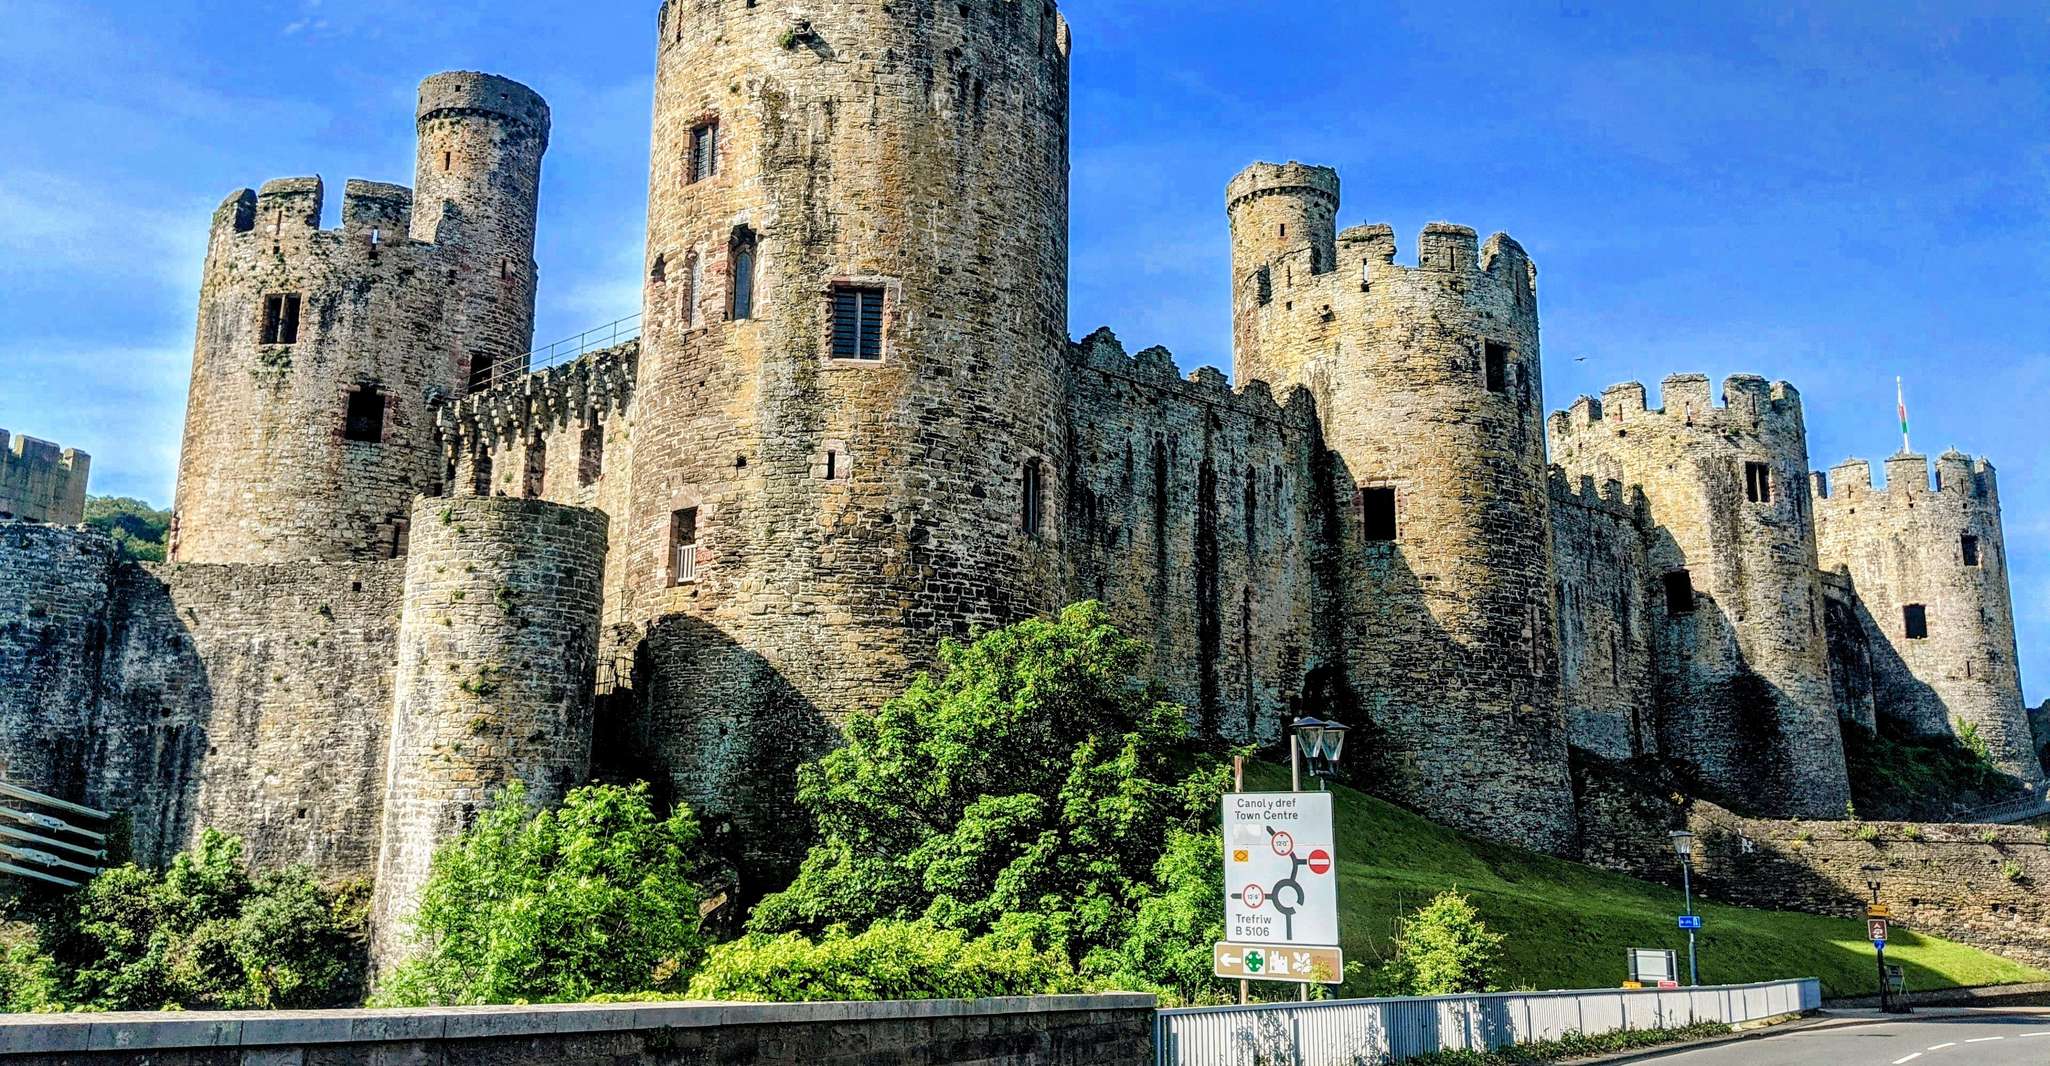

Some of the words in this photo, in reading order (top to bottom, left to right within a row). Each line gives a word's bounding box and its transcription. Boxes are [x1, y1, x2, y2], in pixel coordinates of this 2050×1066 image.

[1237, 798, 1266, 808] Canol
[1268, 800, 1273, 810] y
[1275, 798, 1296, 808] dref
[1234, 810, 1260, 820] Town
[1263, 810, 1298, 820] Centre
[1235, 913, 1272, 924] Trefriw
[1235, 926, 1242, 936] B
[1245, 926, 1270, 937] 5106
